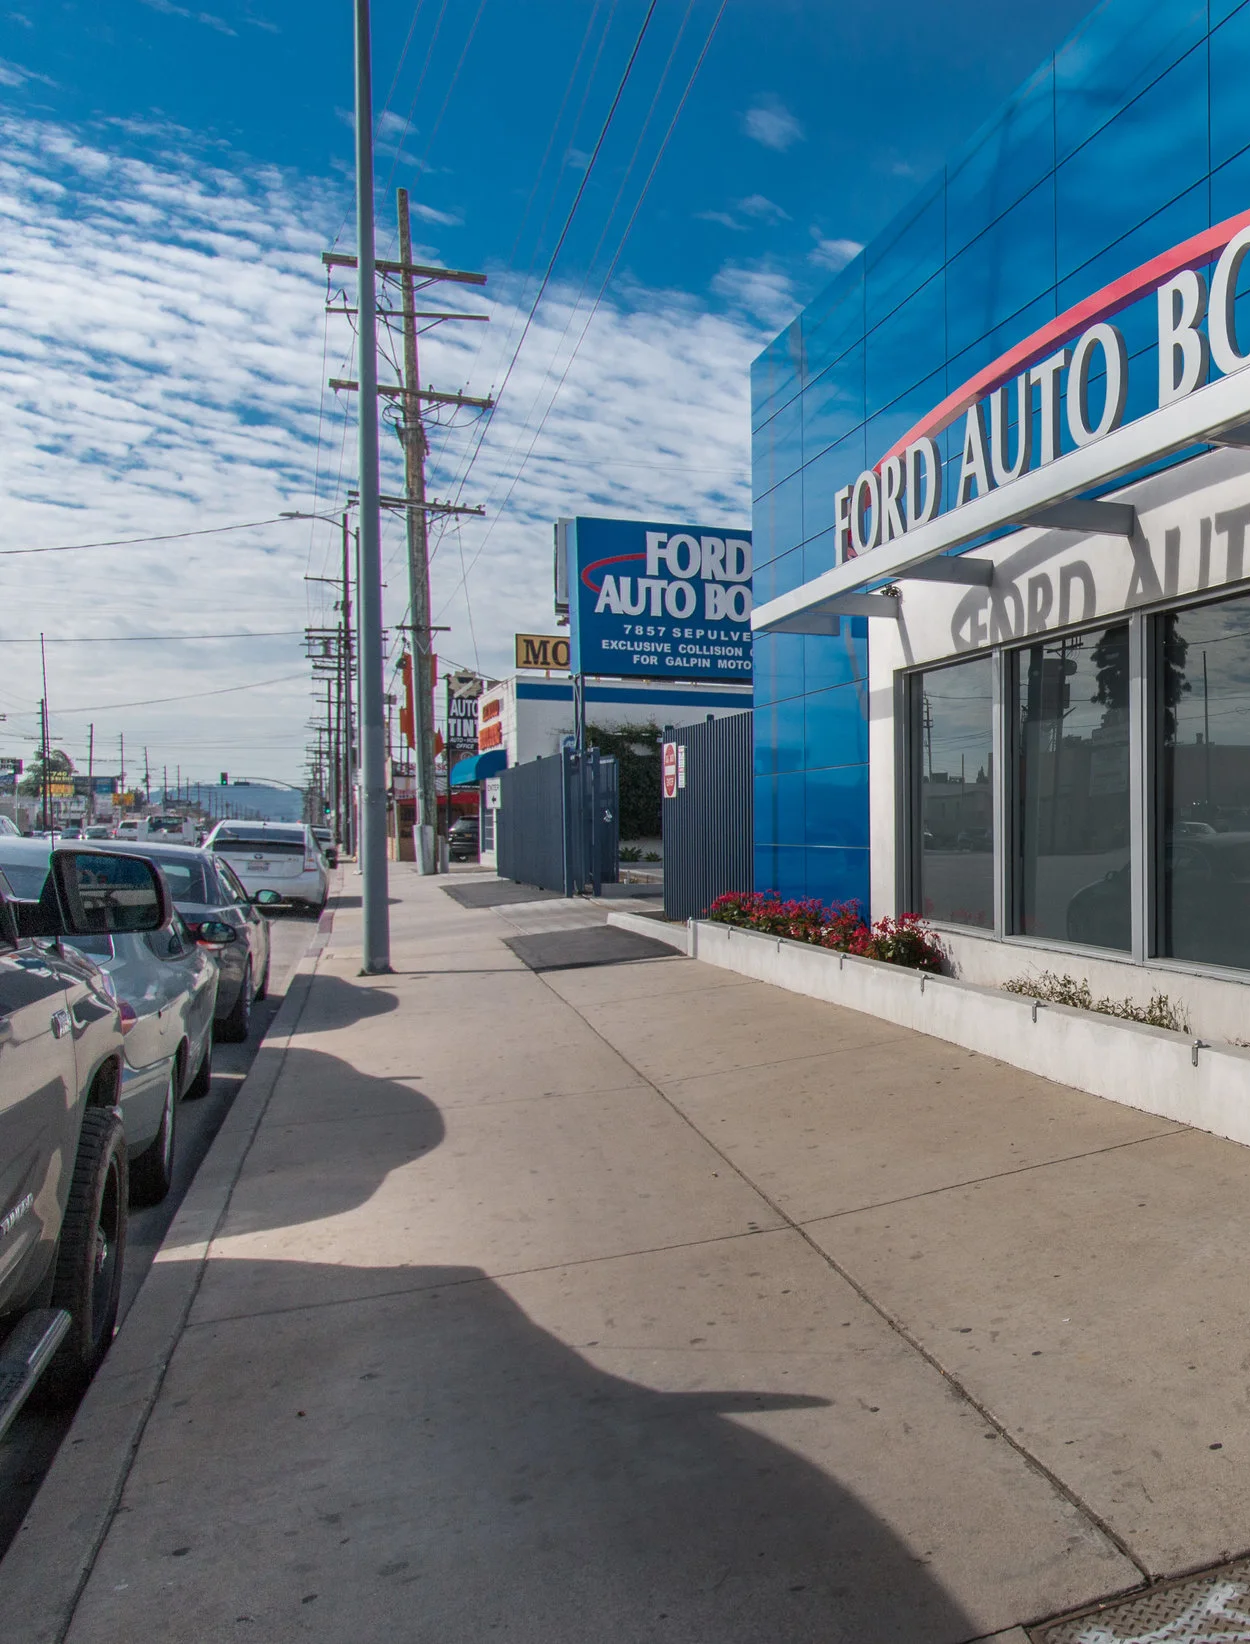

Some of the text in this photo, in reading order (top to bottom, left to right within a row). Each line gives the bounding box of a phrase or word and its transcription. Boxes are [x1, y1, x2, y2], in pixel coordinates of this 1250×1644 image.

[834, 436, 942, 567] FORD
[957, 322, 1128, 508] AUTO
[645, 531, 752, 582] FORD
[594, 574, 696, 619] AUTO
[623, 624, 751, 642] 7857 SEPULVE
[523, 639, 570, 666] MO
[601, 639, 671, 653] EXCLUSIVE
[678, 644, 743, 657] COLLISION
[632, 654, 752, 670] FOR GALPIN MOTO
[450, 698, 478, 717] AUTO
